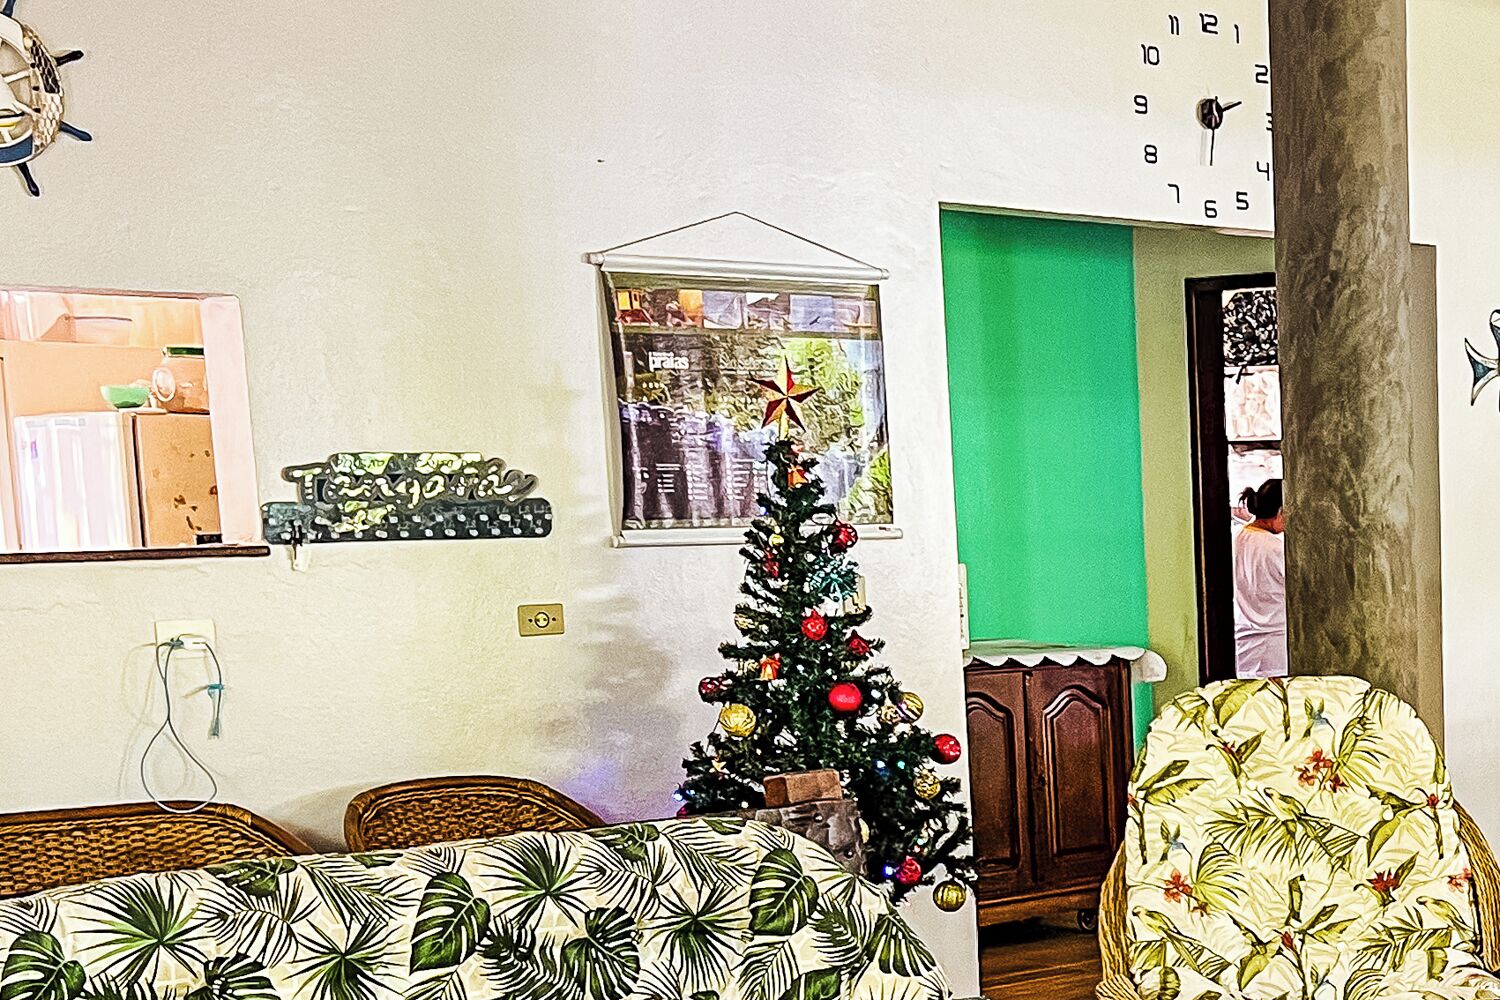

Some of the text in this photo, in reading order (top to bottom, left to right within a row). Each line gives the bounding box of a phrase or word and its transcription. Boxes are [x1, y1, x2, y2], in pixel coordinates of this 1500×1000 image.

[1168, 14, 1180, 35] 11
[1199, 13, 1218, 35] 12
[1234, 24, 1240, 44] 1
[1141, 44, 1160, 66] 10
[1254, 64, 1269, 84] 2
[1134, 95, 1148, 114] 9
[1144, 144, 1158, 164] 8
[1256, 160, 1270, 181] 4
[1167, 183, 1180, 204] 7
[1236, 191, 1249, 210] 5
[1204, 200, 1218, 218] 6
